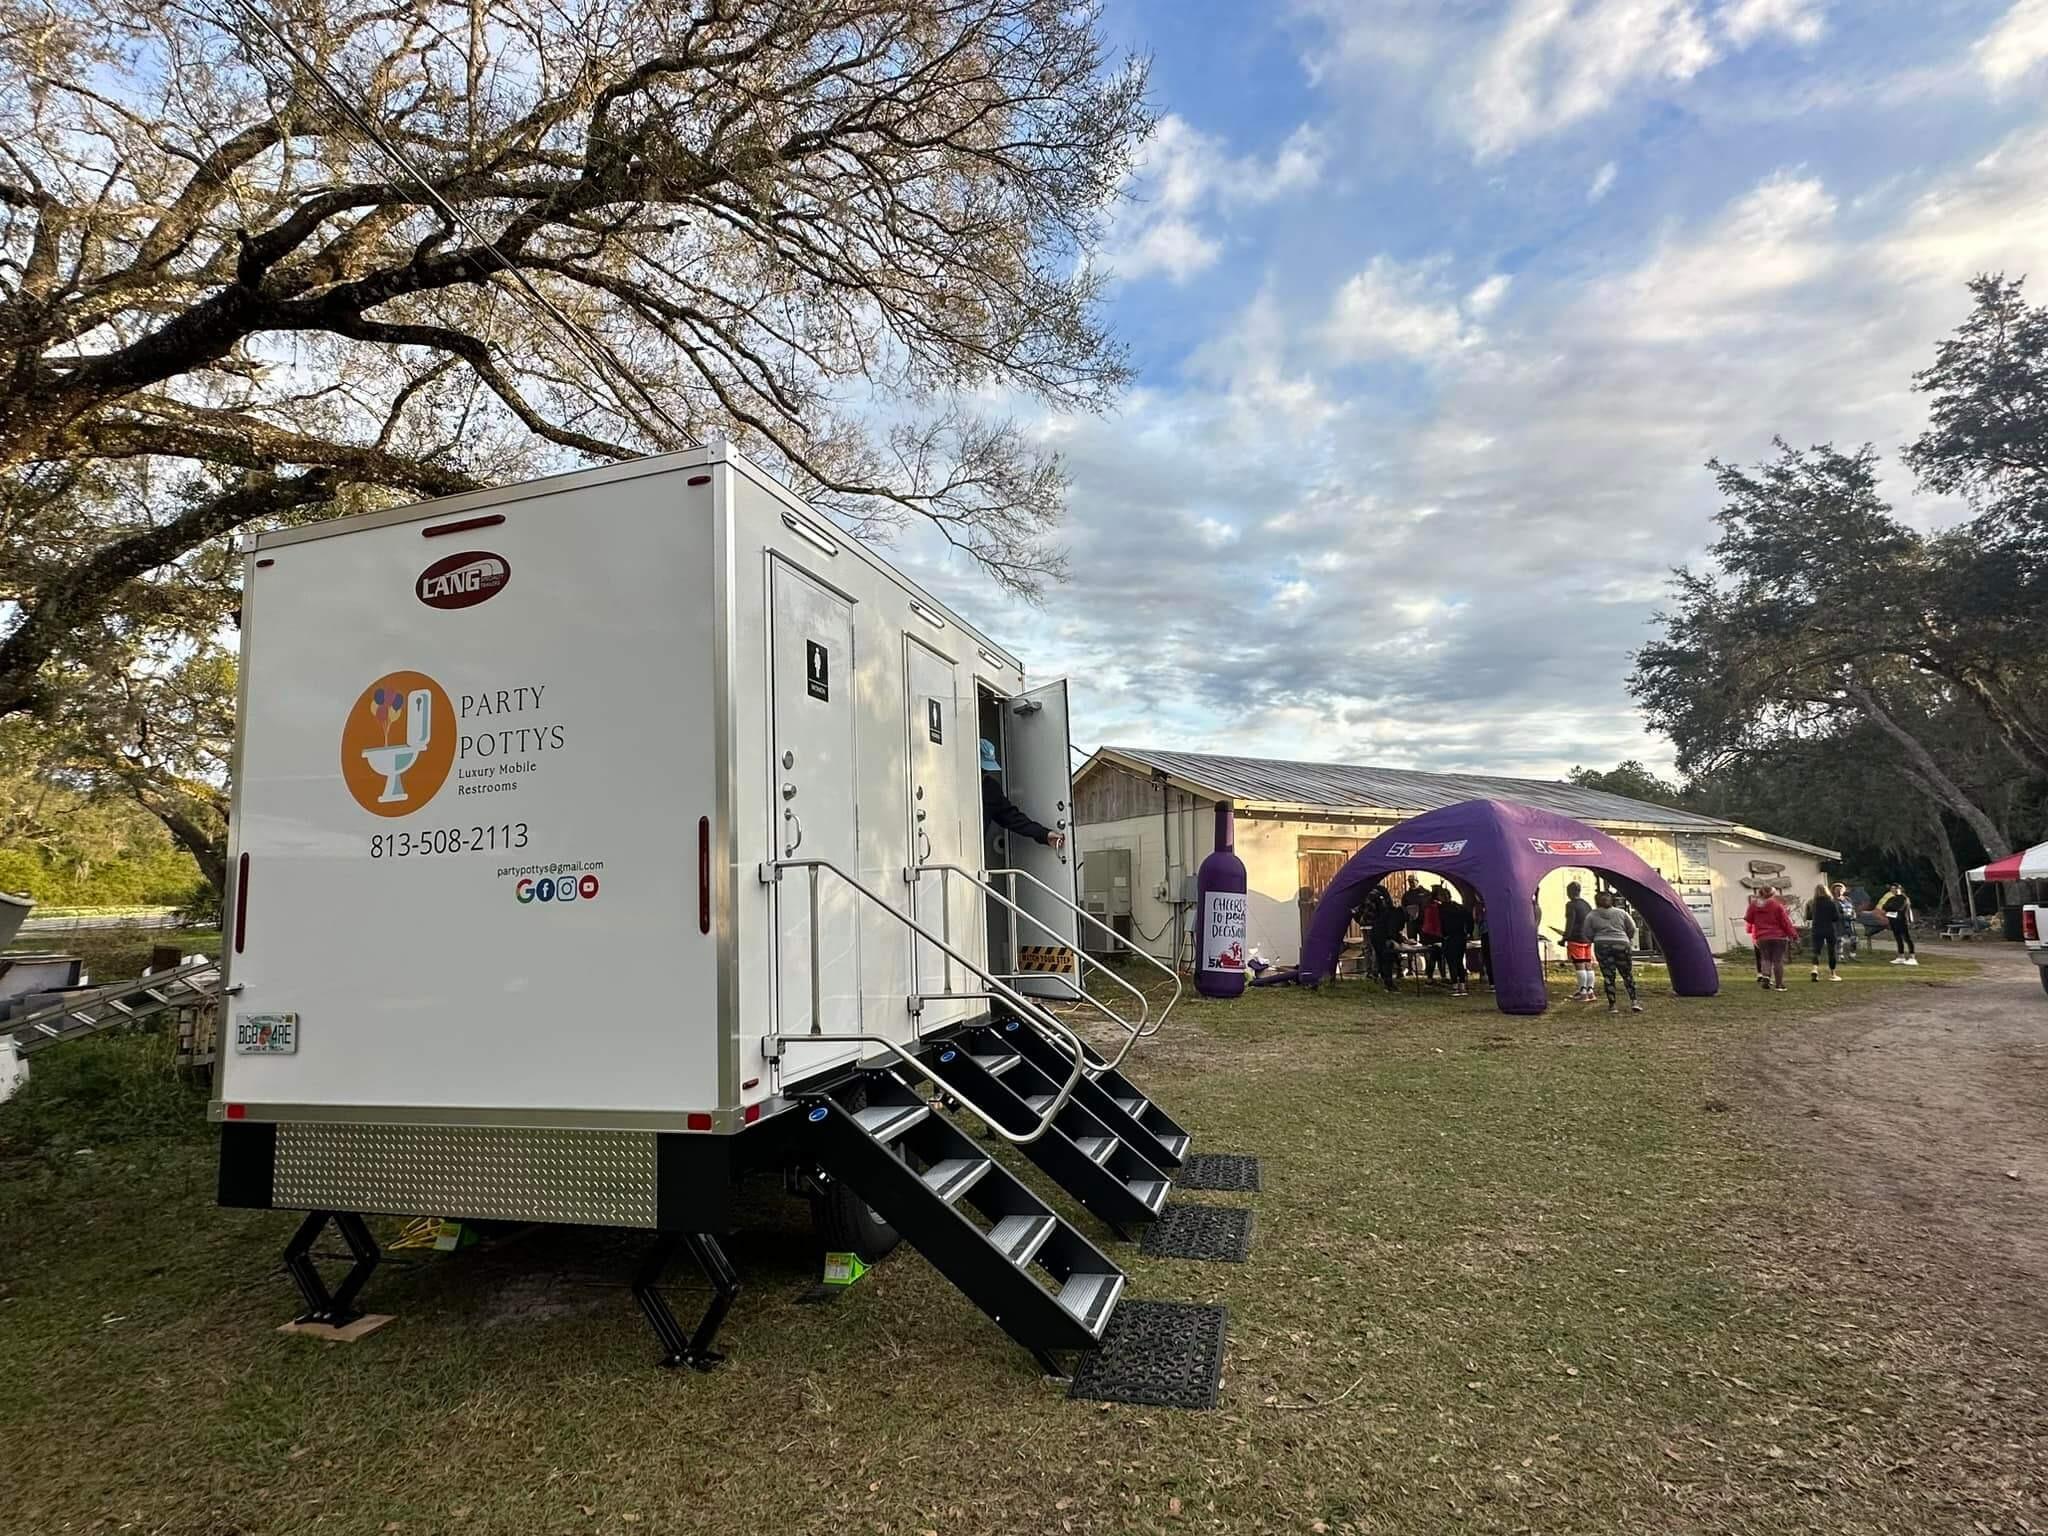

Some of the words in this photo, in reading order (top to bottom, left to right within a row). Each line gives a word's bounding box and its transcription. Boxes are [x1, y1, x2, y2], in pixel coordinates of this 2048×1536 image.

[422, 569, 481, 599] LANG
[461, 685, 545, 718] PARTY
[460, 725, 565, 759] POTTYS
[458, 767, 496, 779] Luxury
[499, 761, 537, 775] Mobile
[458, 782, 518, 796] Restrooms
[370, 823, 530, 858] 813-508-2113
[497, 860, 604, 877] partypottys@gmail.com
[1213, 912, 1223, 924] TO
